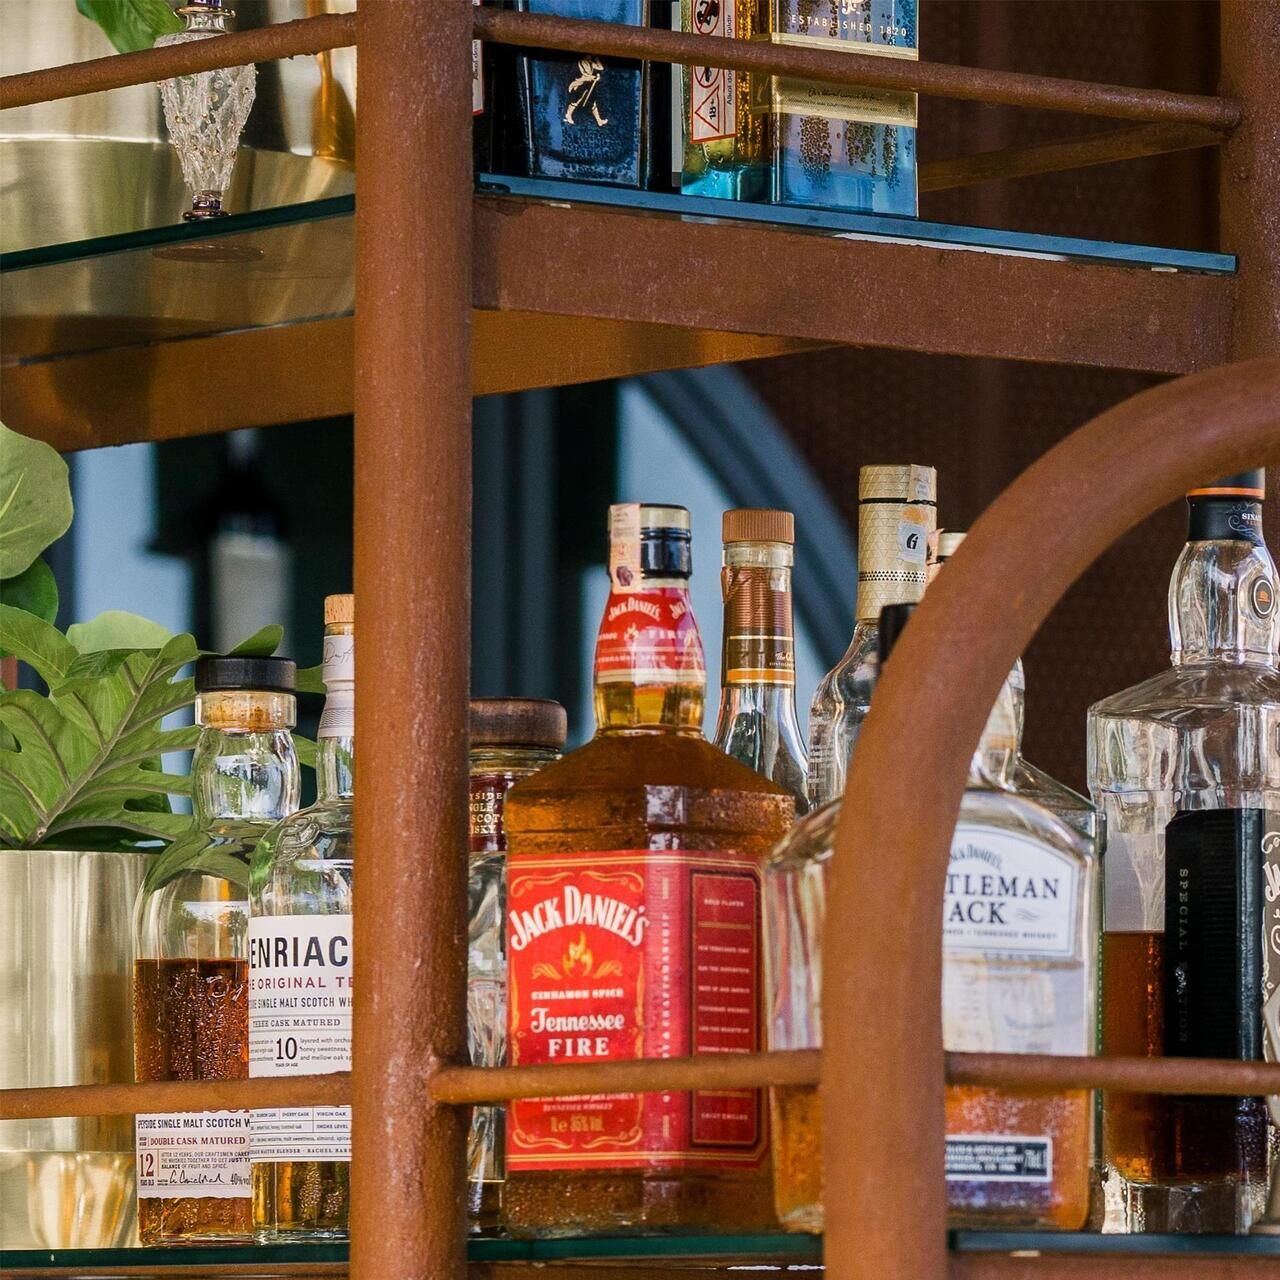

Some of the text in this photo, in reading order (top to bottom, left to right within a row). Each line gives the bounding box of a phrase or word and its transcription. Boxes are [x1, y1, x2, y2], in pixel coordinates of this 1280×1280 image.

[791, 15, 907, 37] ESTABLISHED 1820
[469, 824, 497, 834] ISKY
[947, 874, 1059, 899] TLEMAN
[509, 885, 650, 951] JACK DANIEL'S
[948, 901, 1008, 925] ACK
[1179, 868, 1189, 950] SPECIAL
[250, 935, 348, 969] ENRIAC
[257, 976, 327, 991] ORIGINAL
[531, 988, 624, 1000] CINNAMON SPICE
[258, 998, 277, 1009] SINGLE
[279, 997, 298, 1008] MALT
[301, 996, 335, 1008] SCOTCH
[270, 1019, 290, 1027] CASK
[293, 1018, 341, 1027] MATURED
[530, 1007, 625, 1033] Tennessee
[275, 1036, 298, 1060] 10
[548, 1037, 609, 1057] FIRE
[158, 1118, 242, 1129] SINGLE MALT SCOTCH
[150, 1137, 175, 1146] DOUBLE
[176, 1136, 198, 1145] CASK
[201, 1136, 246, 1145] MATURED
[140, 1153, 154, 1177] 12
